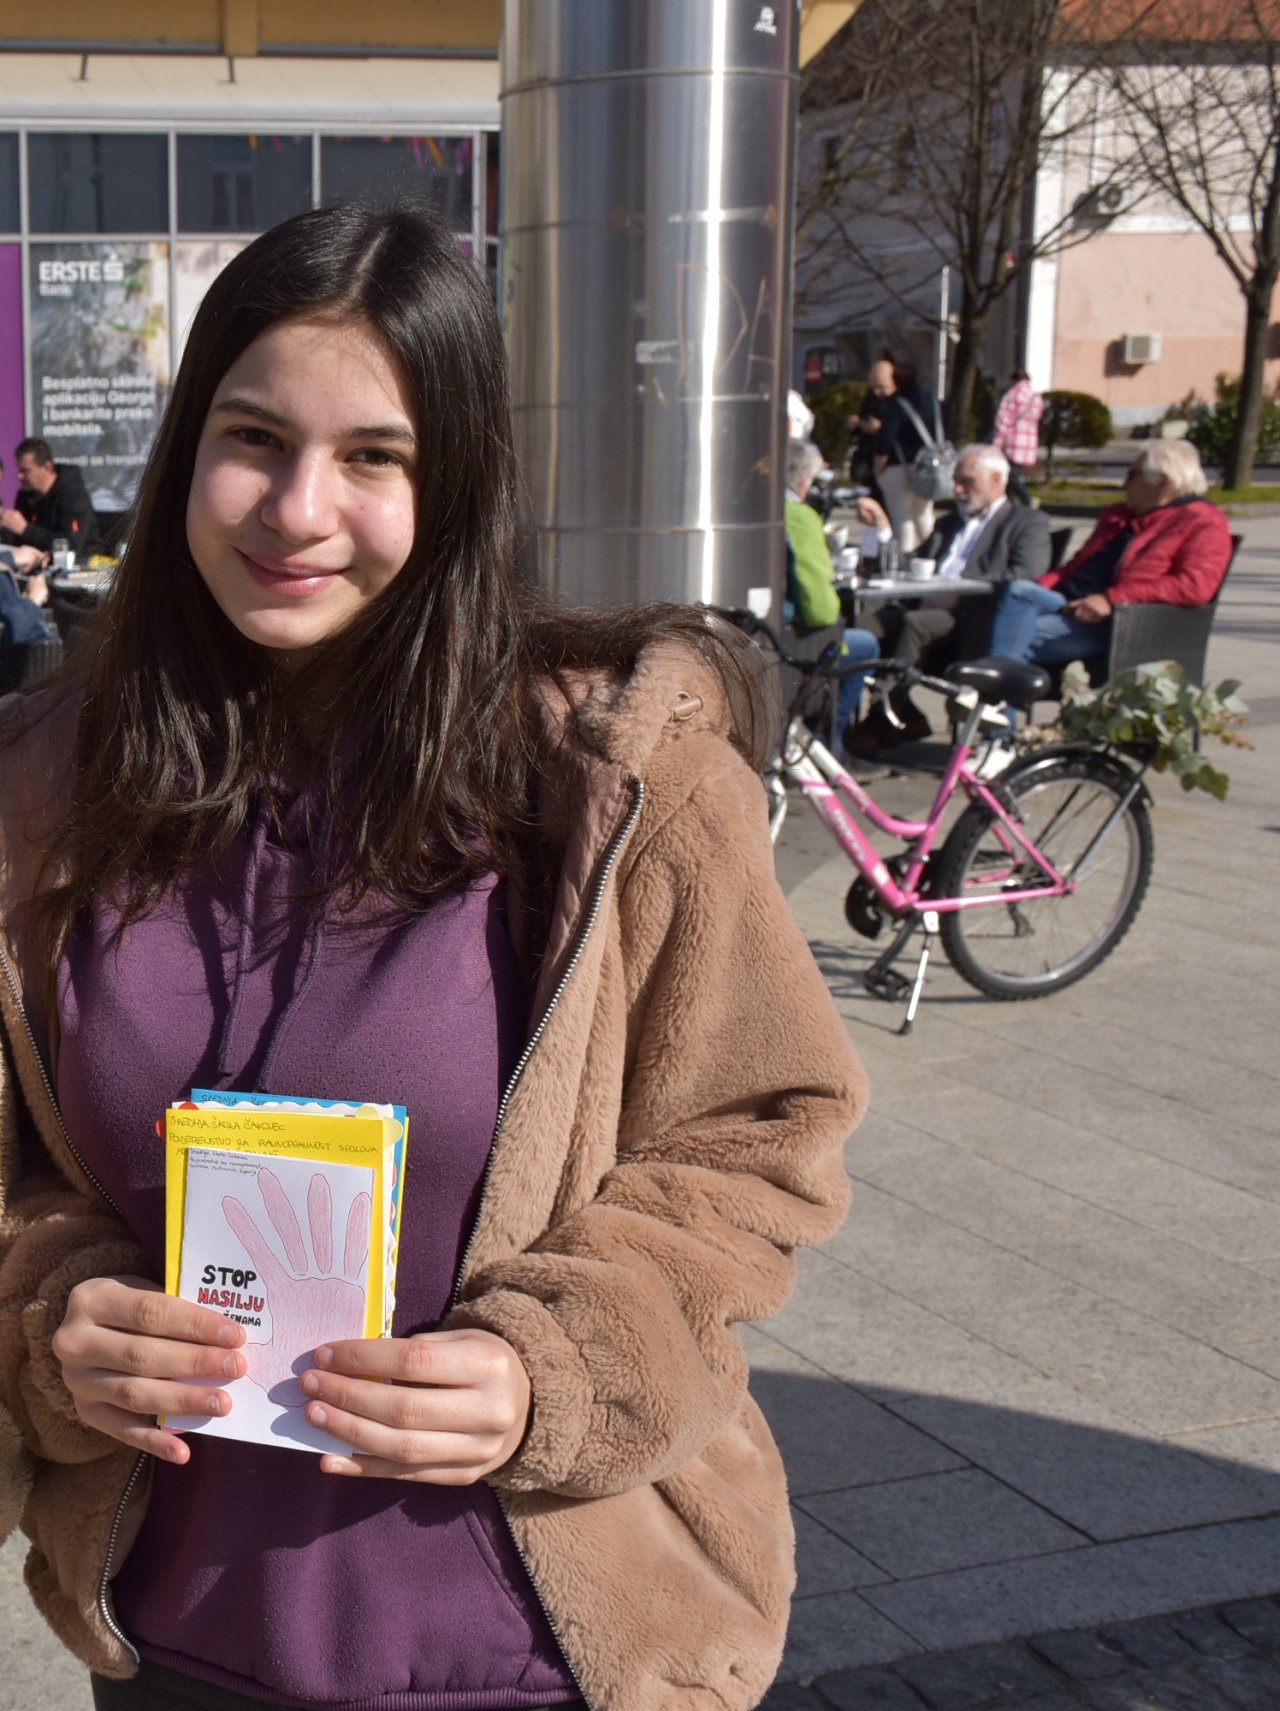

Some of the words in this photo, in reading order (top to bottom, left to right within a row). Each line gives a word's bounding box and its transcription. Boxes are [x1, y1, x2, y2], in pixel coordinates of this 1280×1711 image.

[39, 261, 101, 282] ERSTE
[39, 283, 72, 296] Bank
[42, 376, 109, 391] Besplatno
[42, 391, 106, 407] aplikaciju
[107, 390, 155, 406] George
[49, 406, 113, 421] bankarite
[115, 407, 153, 422] preko
[43, 422, 105, 437] mobitela.
[201, 1264, 257, 1289] STOP
[197, 1287, 264, 1312] NASILJU
